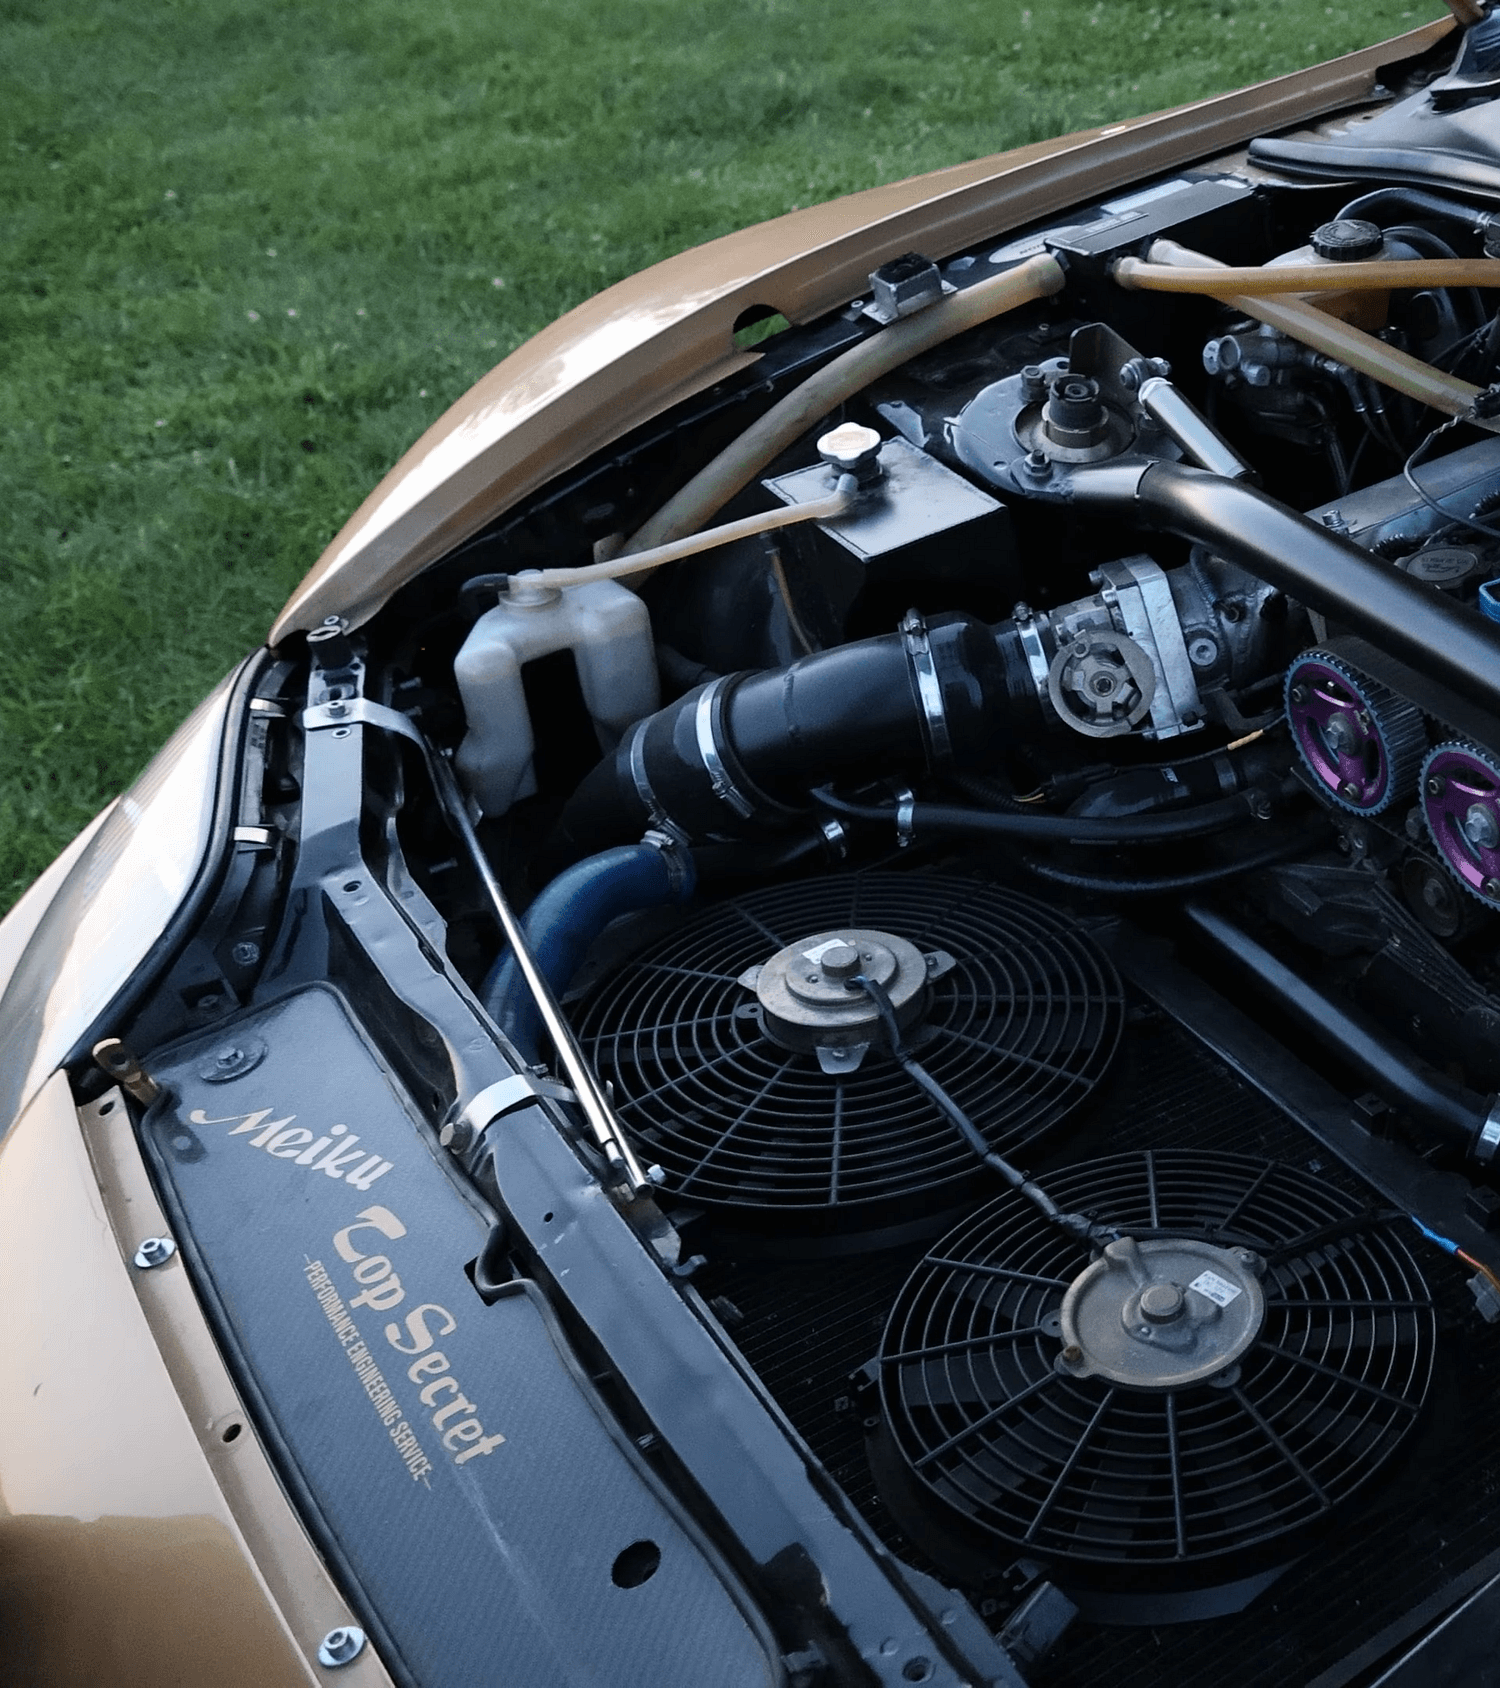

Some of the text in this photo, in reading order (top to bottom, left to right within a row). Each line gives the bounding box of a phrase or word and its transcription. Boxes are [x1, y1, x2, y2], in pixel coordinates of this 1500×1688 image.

[189, 1107, 395, 1191] Meiku
[303, 1259, 432, 1482] PERFORMANCE ENGINEERING SERVICE
[384, 1303, 507, 1466] Secret
